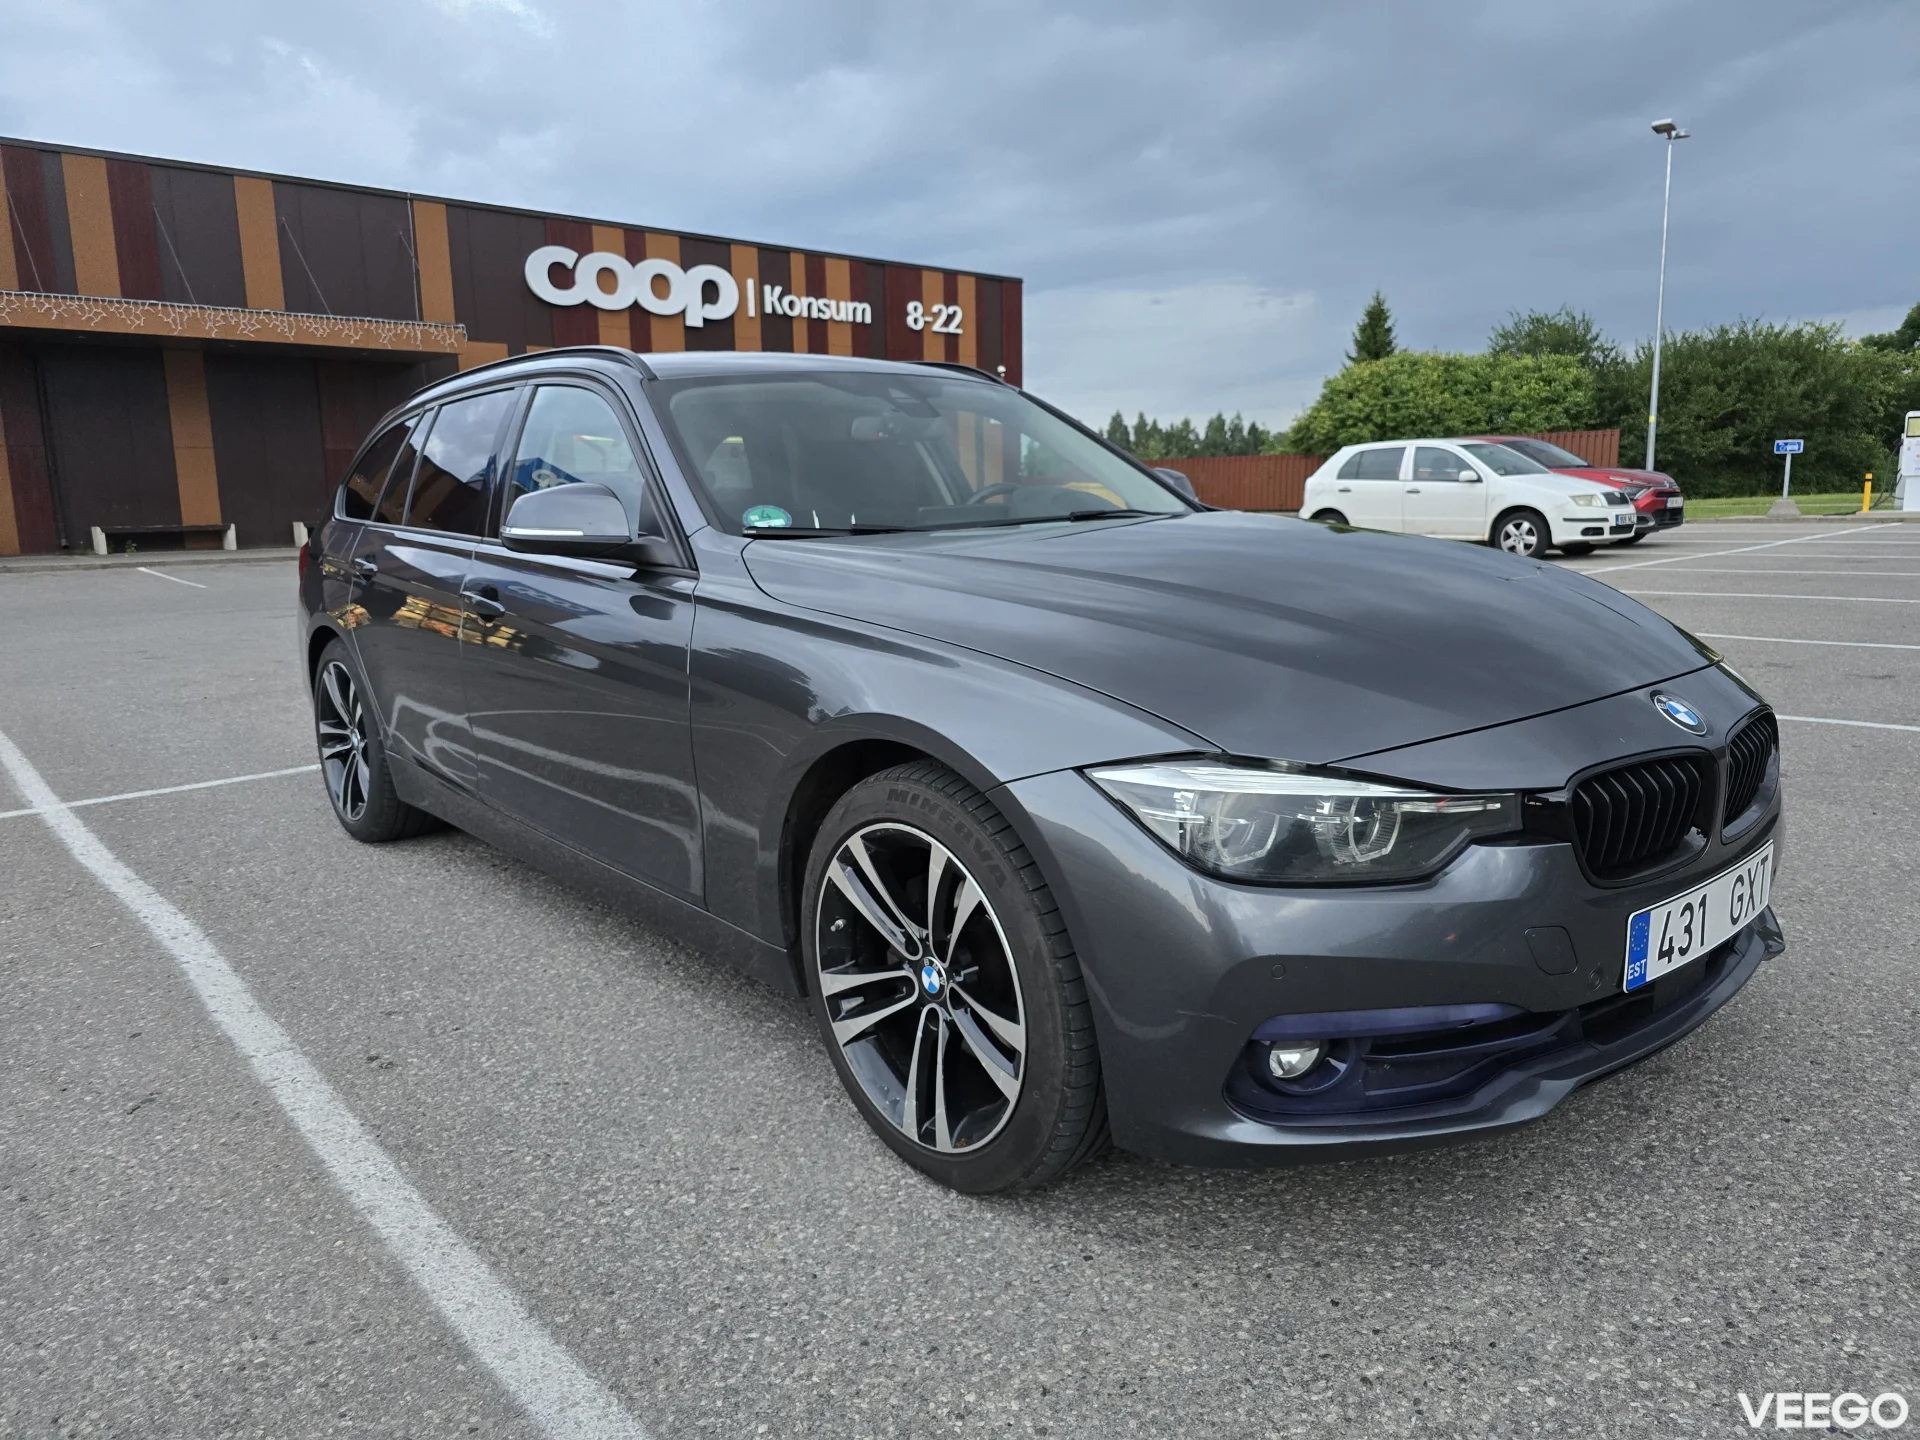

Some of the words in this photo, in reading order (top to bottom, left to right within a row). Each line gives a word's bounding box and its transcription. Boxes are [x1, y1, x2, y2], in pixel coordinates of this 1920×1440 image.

[524, 245, 739, 327] coop
[763, 284, 872, 324] Konsum
[906, 301, 964, 335] 8-22
[886, 788, 1008, 888] MINERVA
[1657, 893, 1708, 964] 431
[1729, 854, 1769, 926] GXT
[923, 958, 946, 986] BMW
[1628, 958, 1647, 980] EST
